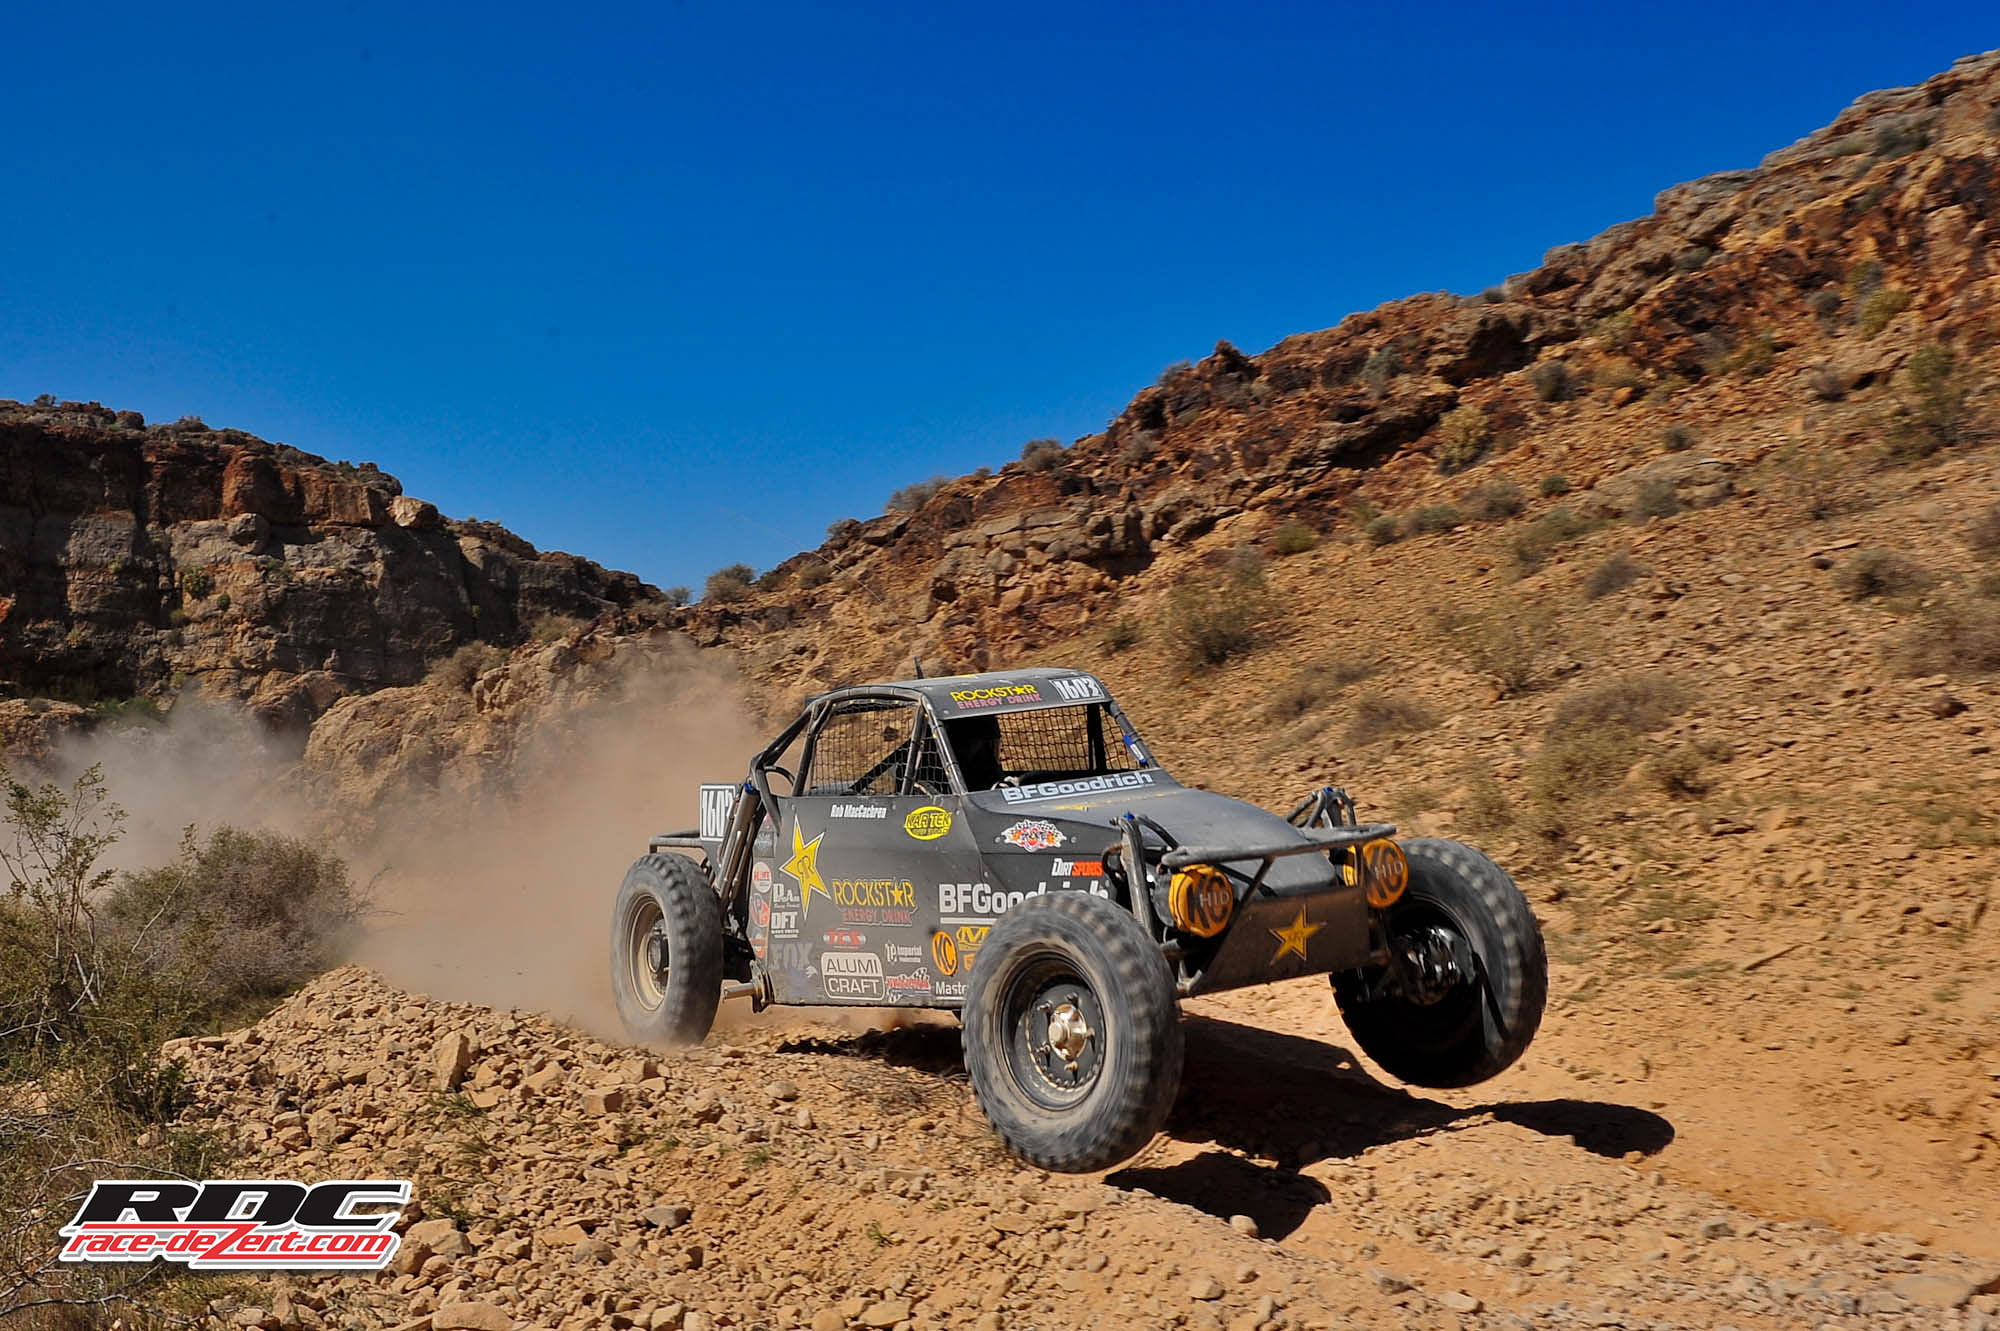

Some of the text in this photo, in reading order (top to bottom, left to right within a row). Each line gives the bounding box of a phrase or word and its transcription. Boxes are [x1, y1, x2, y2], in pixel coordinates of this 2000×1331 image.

[957, 693, 1042, 709] ENERGY DRINK
[1002, 772, 1153, 802] BFGoodrich
[1200, 890, 1230, 908] HID
[771, 912, 798, 929] DFT
[843, 909, 911, 923] ENERGY DRINK
[825, 932, 861, 945] TCS
[827, 958, 878, 974] ALUMI
[828, 978, 880, 995] CRAFT
